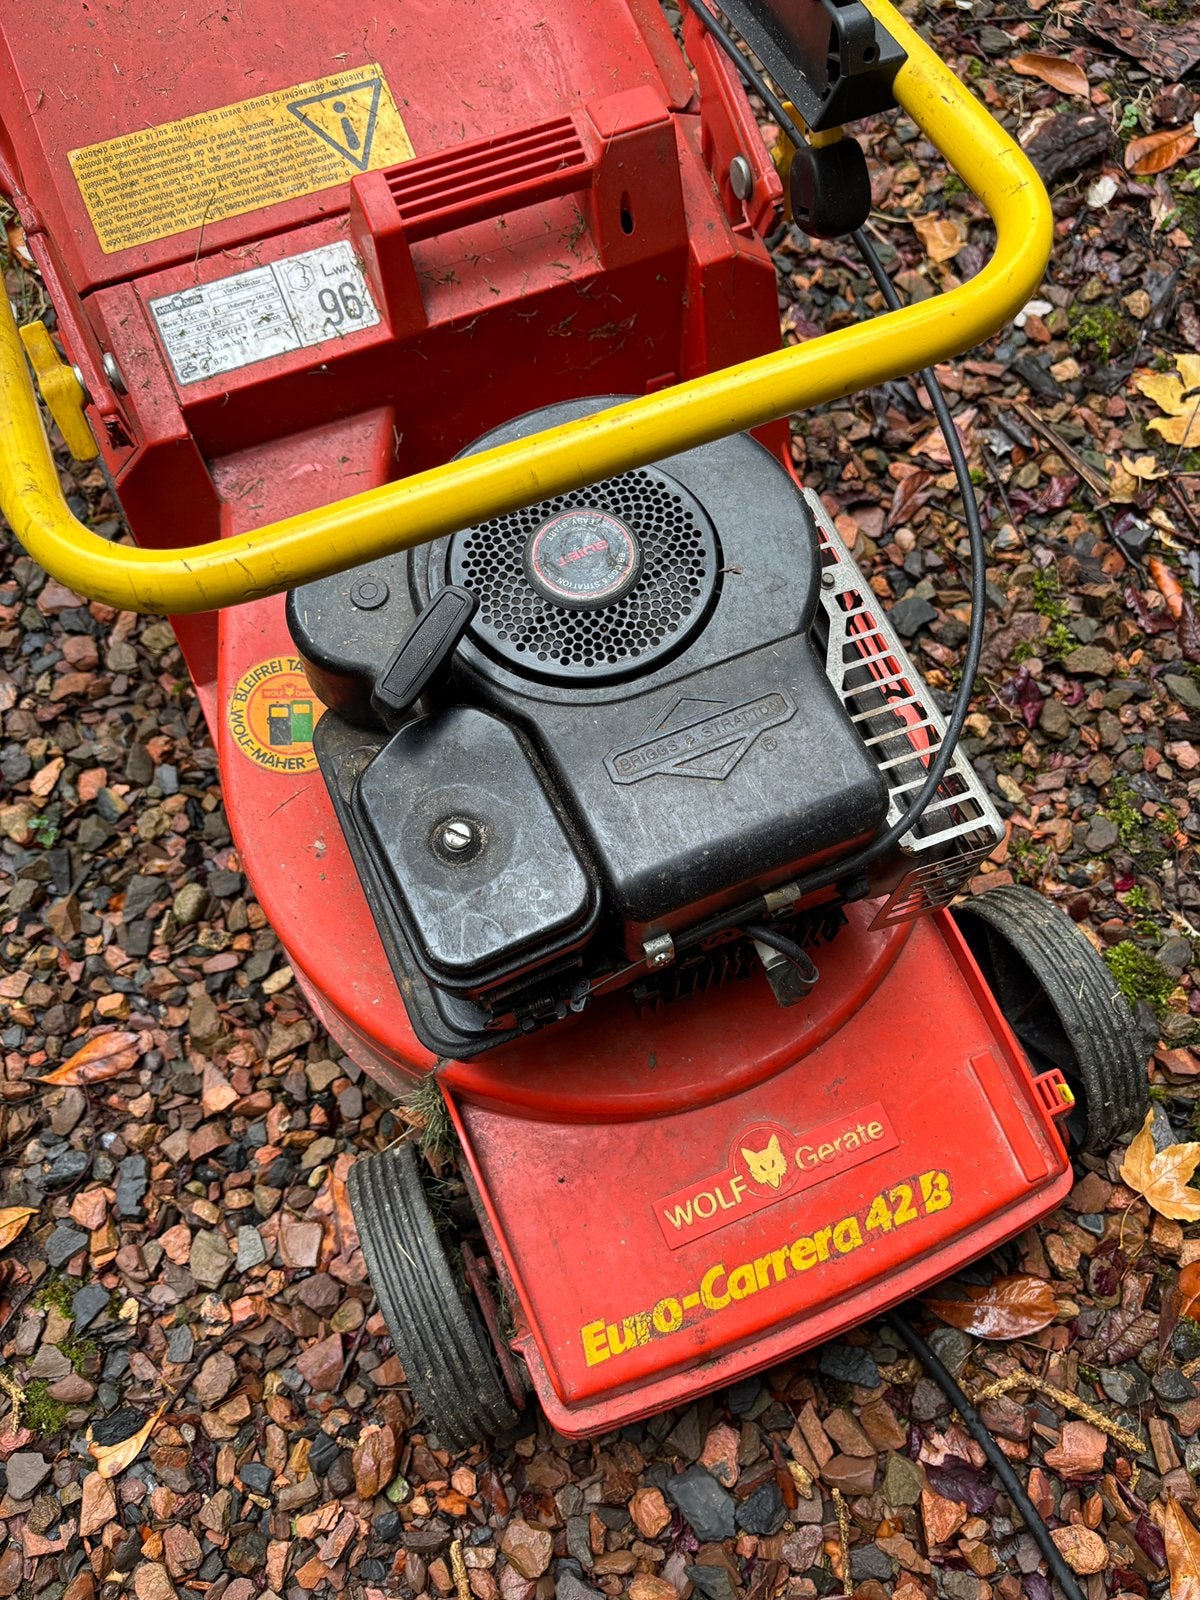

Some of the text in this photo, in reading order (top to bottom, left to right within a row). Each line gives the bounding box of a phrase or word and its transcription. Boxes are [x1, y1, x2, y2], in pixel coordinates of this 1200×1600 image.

[219, 107, 242, 119] avant
[192, 149, 205, 158] der
[224, 149, 241, 159] oder
[252, 151, 268, 161] oder
[279, 154, 294, 164] oder
[102, 155, 114, 164] del
[79, 167, 109, 181] staccare
[238, 167, 251, 176] des
[181, 173, 194, 183] das
[199, 177, 216, 188] oder
[173, 185, 189, 196] dem
[188, 182, 200, 190] vor
[105, 195, 119, 206] und
[128, 200, 139, 209] die
[161, 222, 173, 231] mit
[173, 217, 187, 227] Nur
[105, 237, 121, 248] oder
[318, 282, 365, 327] 96
[559, 539, 609, 568] QUIET
[234, 660, 283, 703] BLEIFREI
[617, 739, 679, 773] BRIGGS
[701, 700, 780, 738] STRATTON
[663, 1174, 749, 1231] WOLF
[579, 1215, 863, 1368] Euro-Carrera
[864, 1184, 919, 1233] 42
